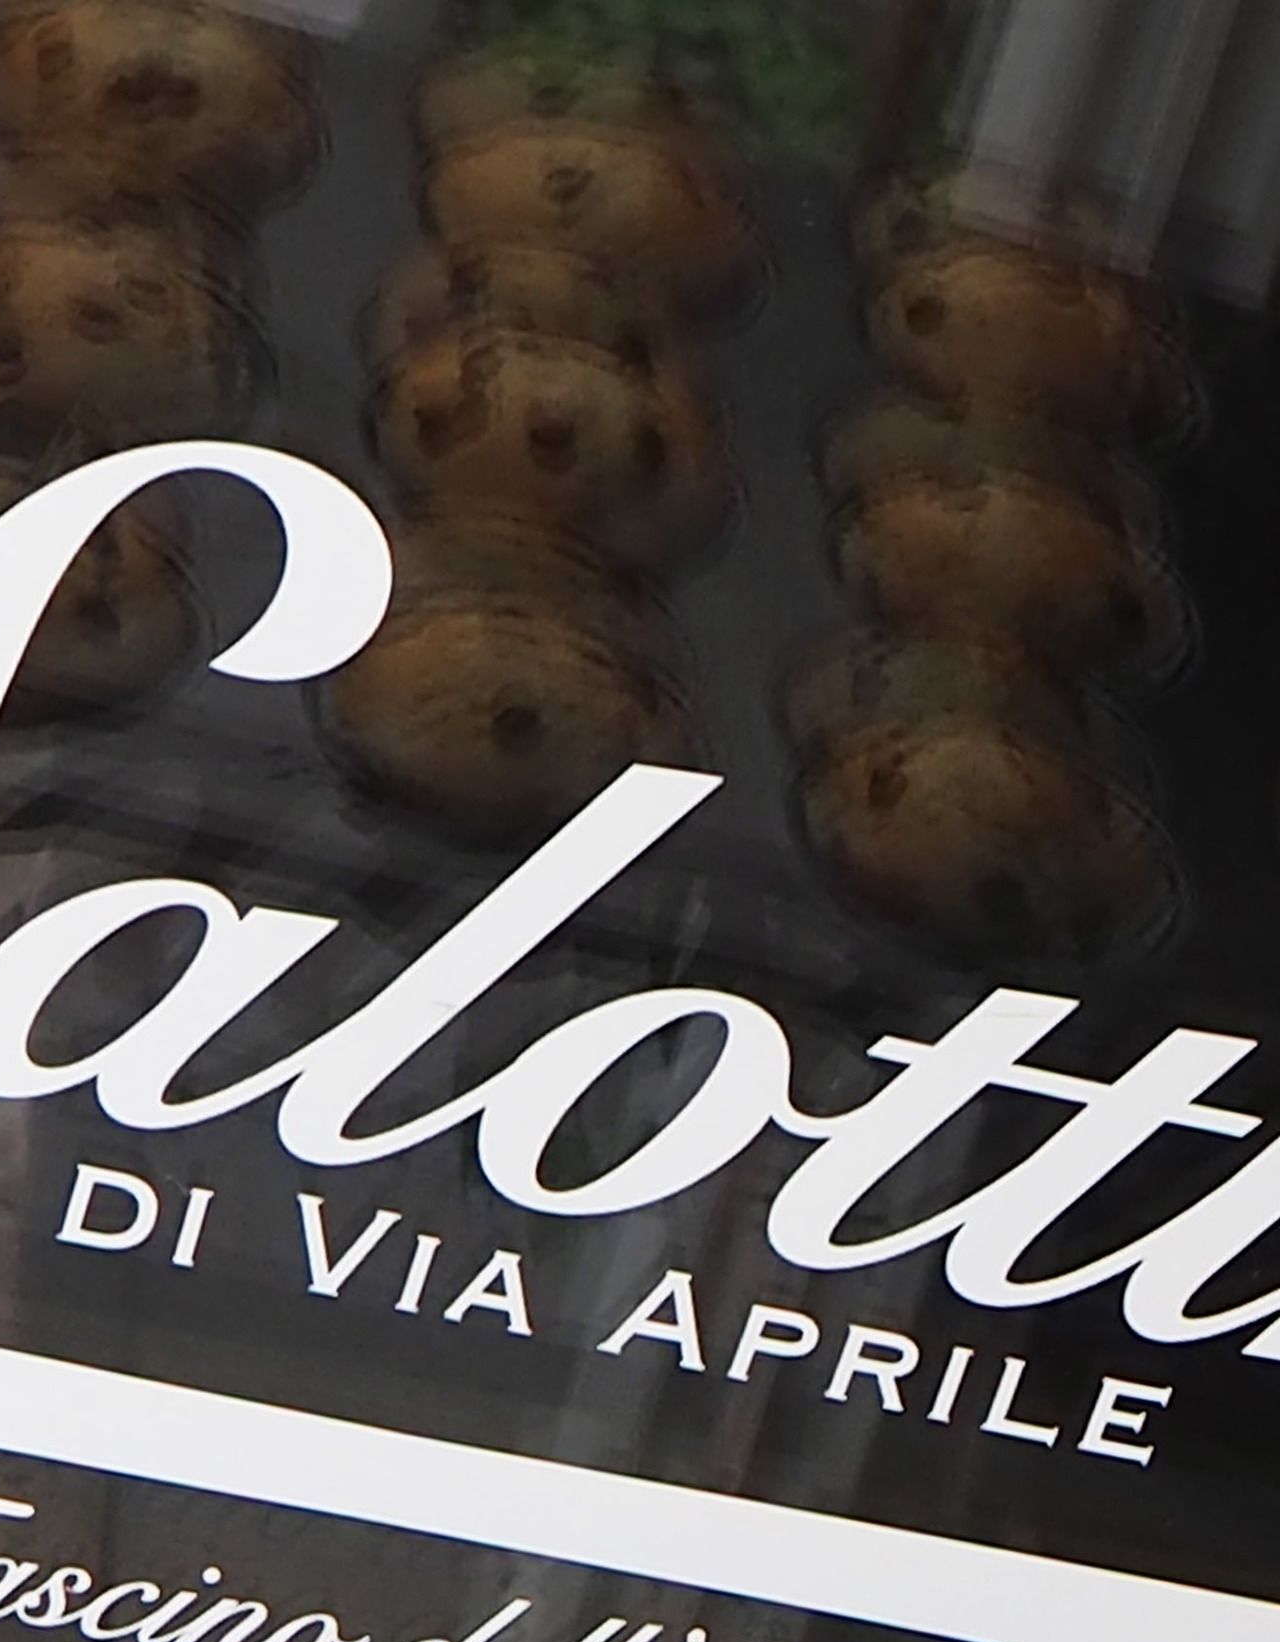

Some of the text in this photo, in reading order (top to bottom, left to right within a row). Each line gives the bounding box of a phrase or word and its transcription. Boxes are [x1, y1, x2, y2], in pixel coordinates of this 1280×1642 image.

[56, 1163, 1173, 1465] DI VIA APRILE
